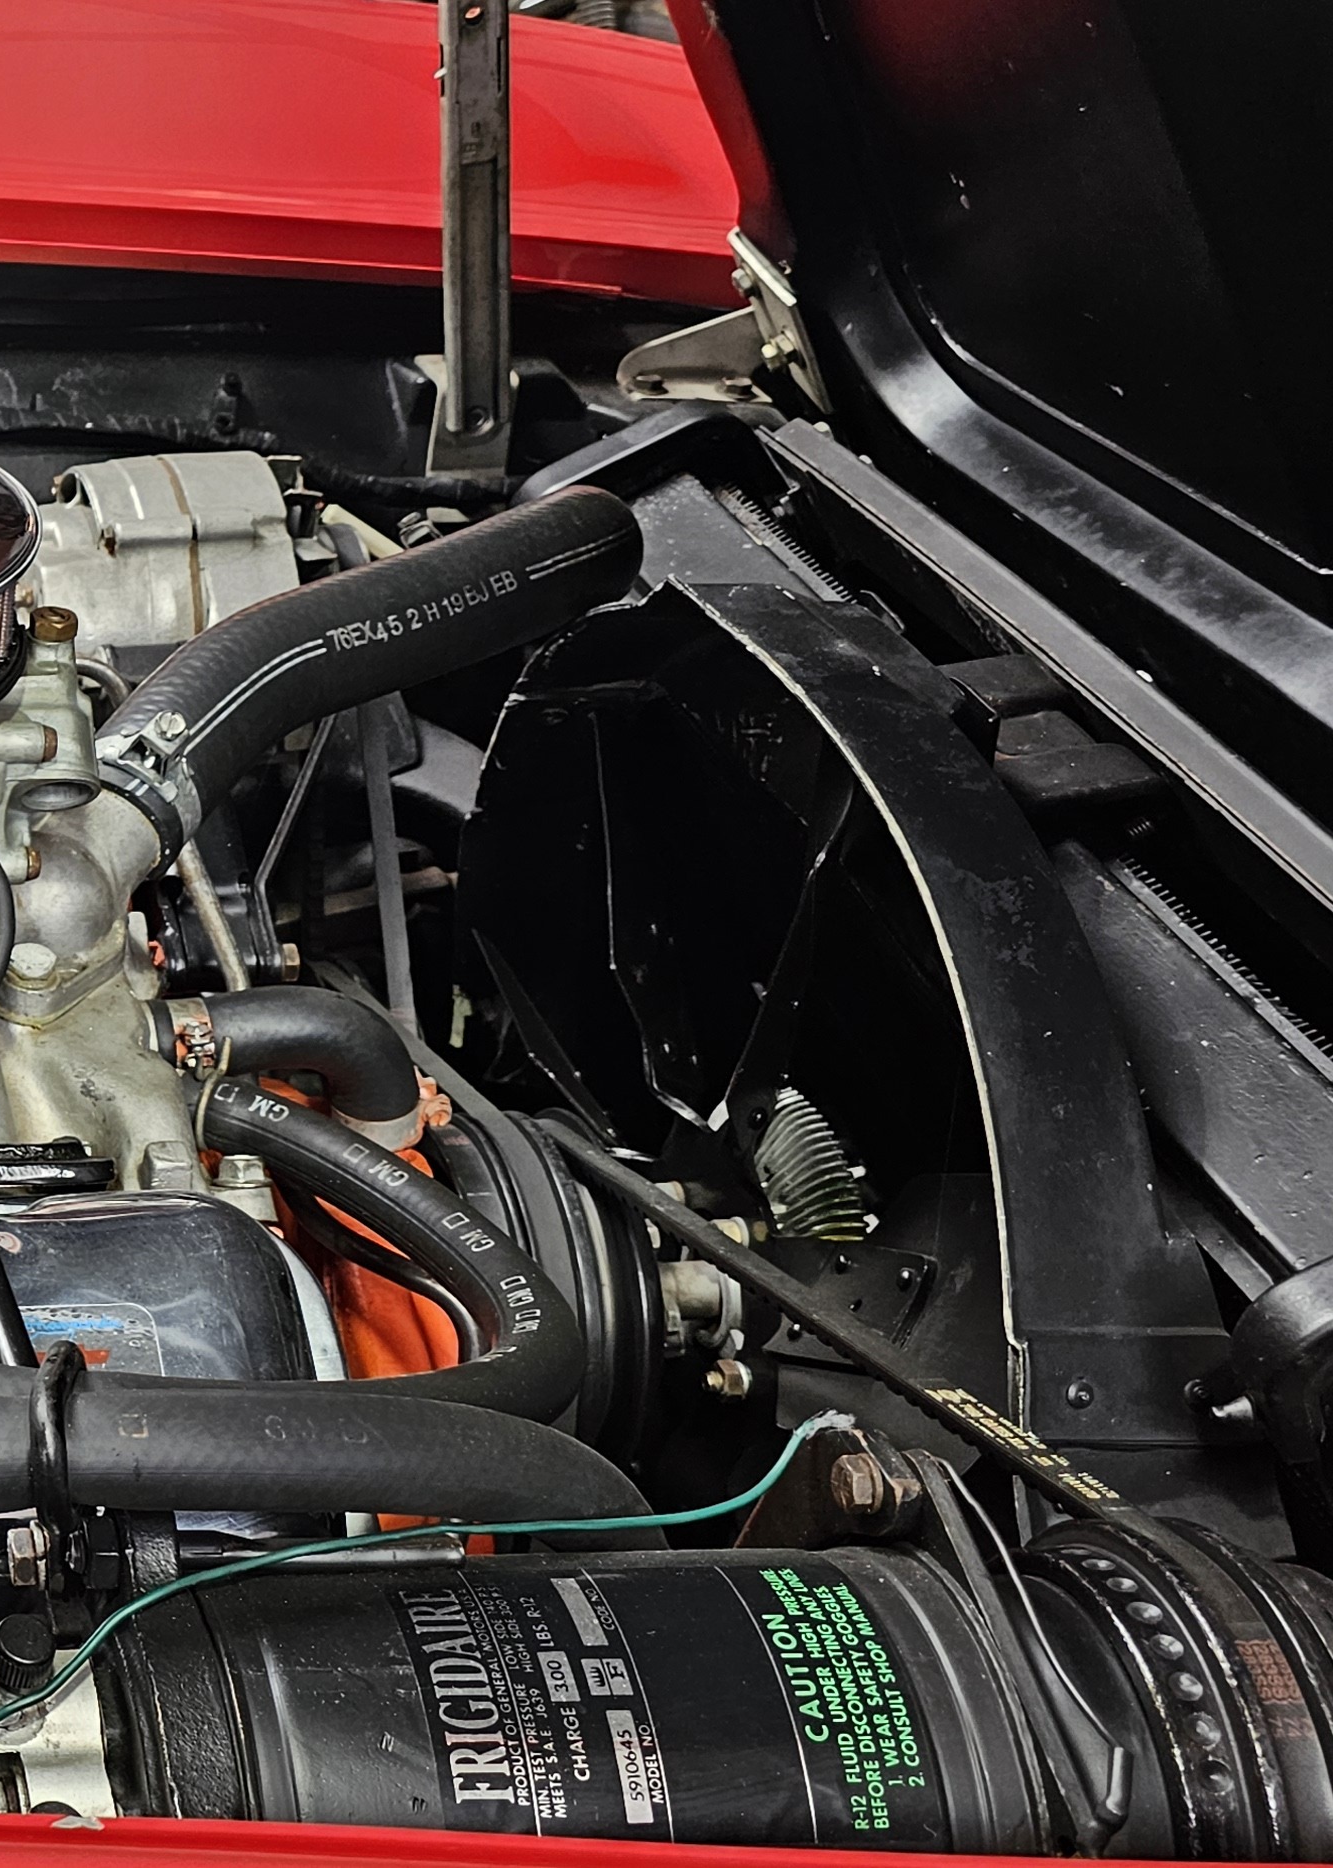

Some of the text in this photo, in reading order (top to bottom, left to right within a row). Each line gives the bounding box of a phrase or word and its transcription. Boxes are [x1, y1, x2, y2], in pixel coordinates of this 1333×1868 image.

[248, 1095, 290, 1122] GM
[368, 1160, 409, 1187] GM
[460, 1229, 495, 1252] GM
[491, 1618, 507, 1638] SIDE
[507, 1618, 523, 1638] SIDE
[520, 1596, 542, 1618] R-12
[595, 1605, 615, 1630] CODE
[798, 1595, 827, 1621] ANY
[470, 1610, 494, 1652] MOTORS
[795, 1622, 825, 1658] HIGH
[503, 1645, 521, 1670] LOW
[517, 1643, 535, 1672] HIGH
[761, 1612, 830, 1742] CAUTION
[864, 1640, 896, 1683] SHOP
[400, 1588, 515, 1804] FRIGIDAIRE
[489, 1657, 512, 1713] GENERAL
[530, 1688, 549, 1718] J639
[813, 1585, 904, 1786] 1. WEAR SAFETY GOGGLES
[817, 1623, 876, 1753] DISCONNECTING
[817, 1667, 846, 1722] UNDER
[504, 1718, 518, 1735] OF
[560, 1706, 590, 1781] CHARGE
[885, 1689, 920, 1767] CONSULT
[514, 1683, 553, 1818] MIN. TEST PRESSURE
[617, 1729, 645, 1801] 5910645
[837, 1733, 862, 1783] FLUID
[507, 1740, 531, 1806] PRODUCT
[643, 1753, 664, 1804] MODEL
[864, 1760, 890, 1828] BEFORE
[909, 1771, 925, 1787] 2.
[550, 1773, 567, 1818] MEETS
[851, 1795, 870, 1829] R-12
